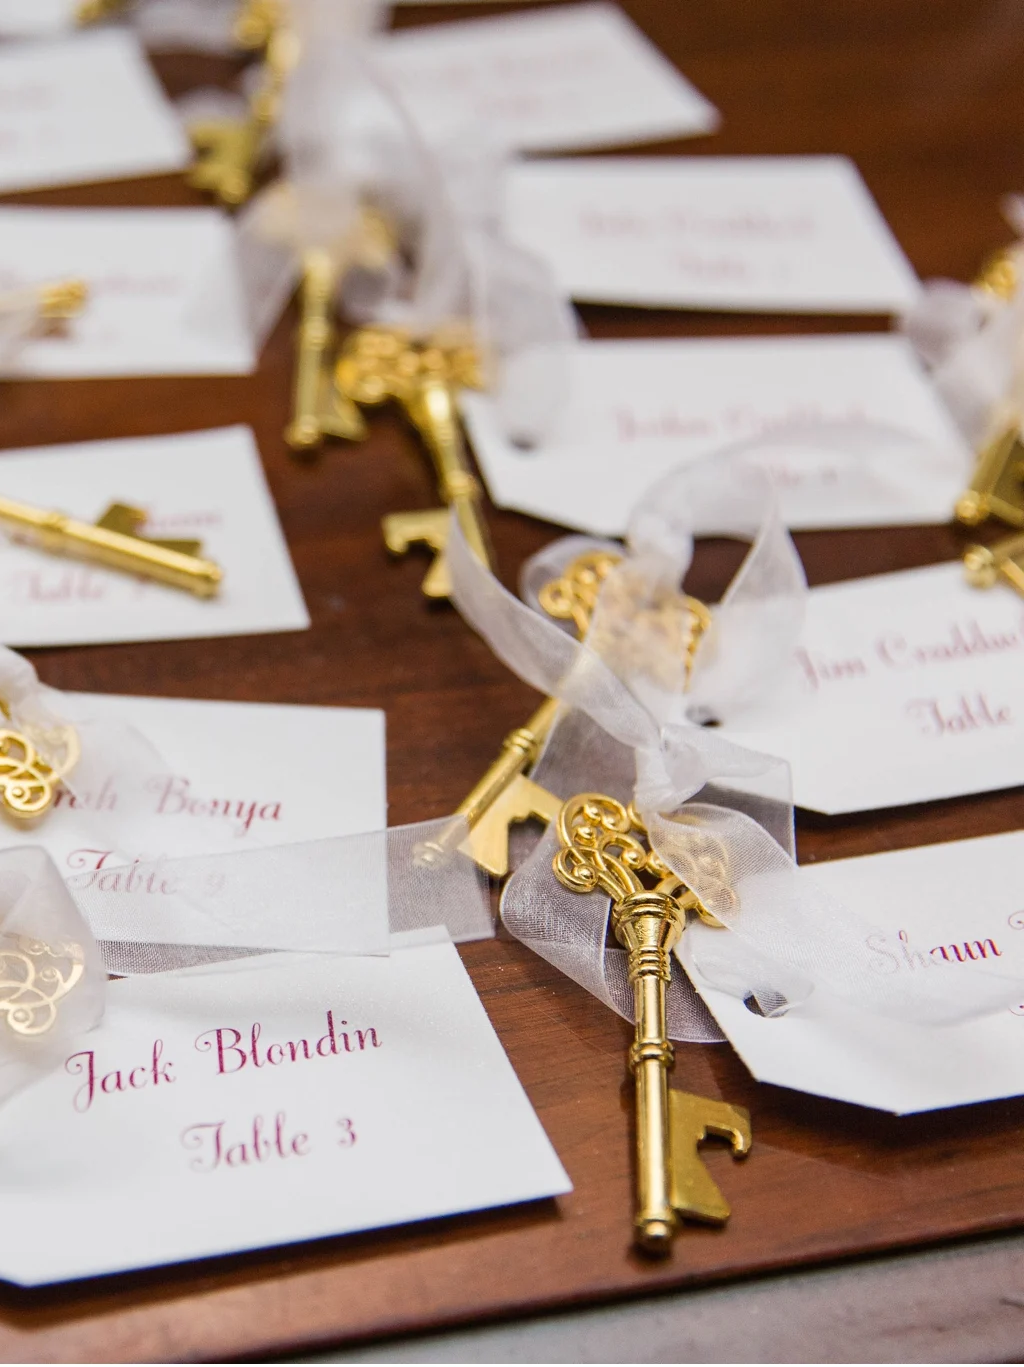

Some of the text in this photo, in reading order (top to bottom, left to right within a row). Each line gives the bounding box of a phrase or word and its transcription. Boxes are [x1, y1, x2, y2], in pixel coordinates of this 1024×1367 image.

[792, 645, 867, 693] Jim
[904, 692, 1014, 738] Table
[67, 848, 179, 895] Table
[64, 1010, 383, 1114] Jack Blondin
[179, 1110, 359, 1173] Table 3
